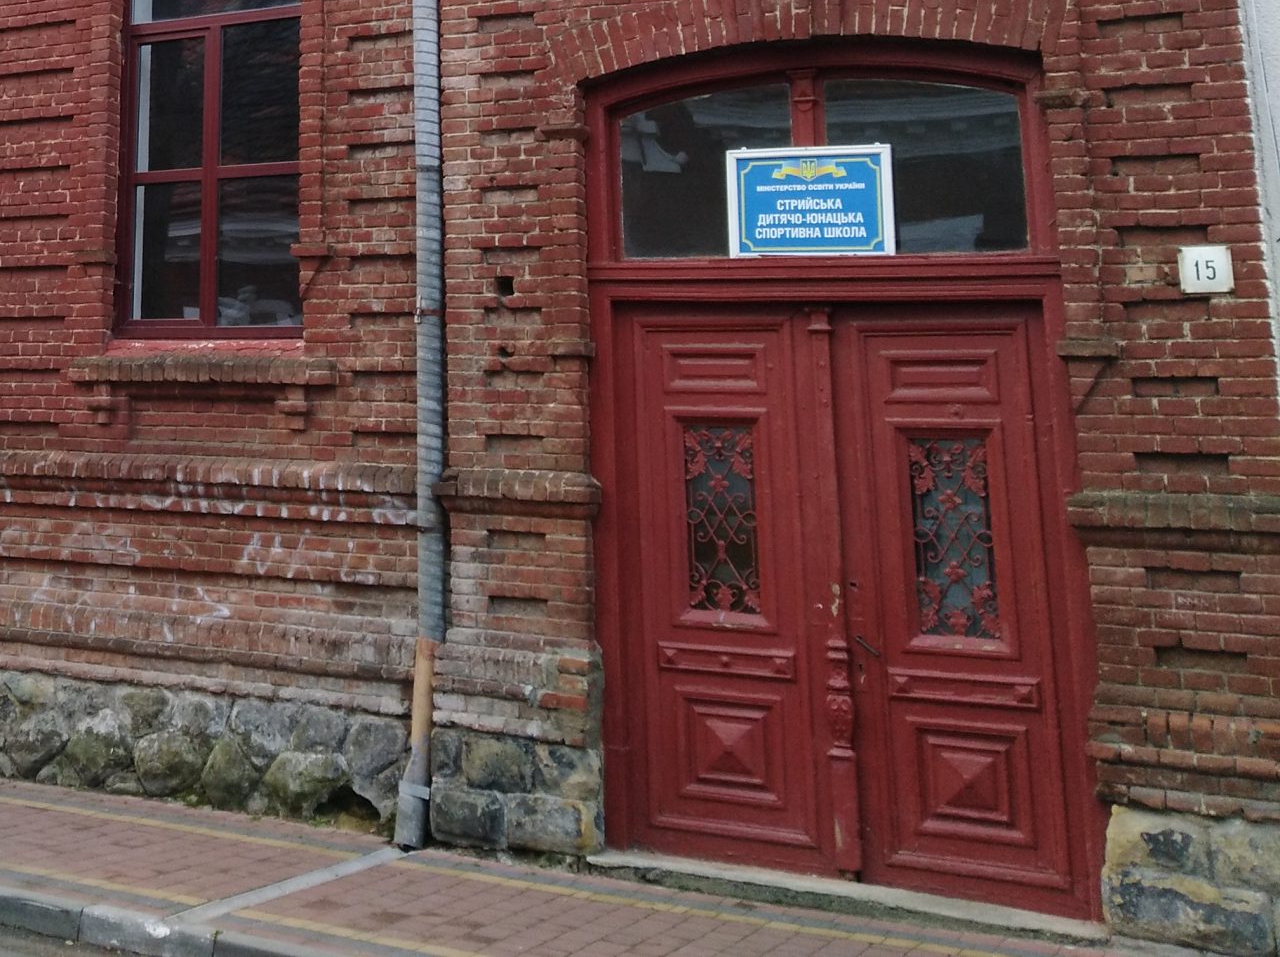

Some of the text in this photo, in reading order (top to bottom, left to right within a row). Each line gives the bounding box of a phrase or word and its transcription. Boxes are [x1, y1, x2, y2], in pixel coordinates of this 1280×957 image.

[756, 182, 865, 192] МІНІСТЕРСТВО ОСВІТИ УКРАЇНИ
[776, 196, 843, 211] СТРИЙСЬКА
[757, 212, 864, 227] ДИТЯЧО-ЮНАЦЬКА
[755, 226, 867, 239] СПОРТИВНА ШКОЛА
[1194, 260, 1216, 281] 15
